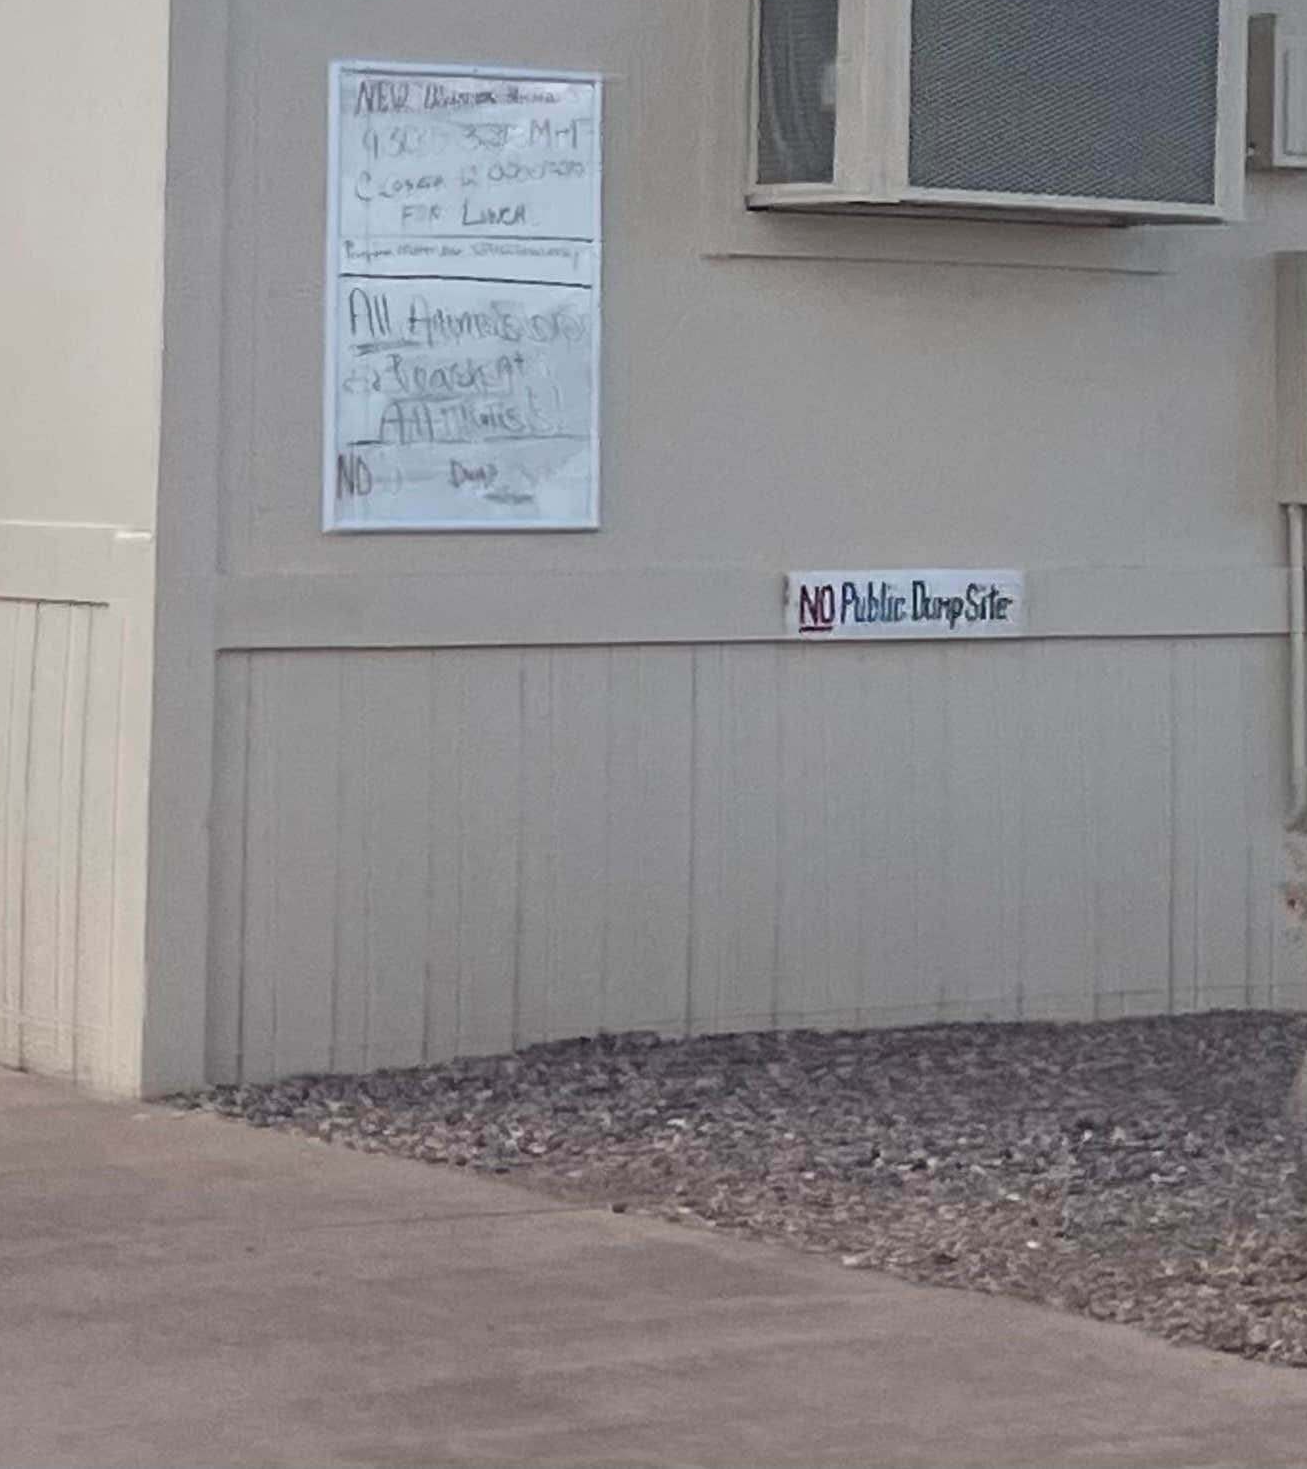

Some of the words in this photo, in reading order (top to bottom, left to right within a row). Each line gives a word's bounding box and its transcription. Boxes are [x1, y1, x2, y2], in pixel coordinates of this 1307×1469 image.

[799, 584, 836, 624] NO
[840, 581, 907, 624] Public
[912, 580, 964, 629] Dump
[965, 582, 1013, 622] Site
